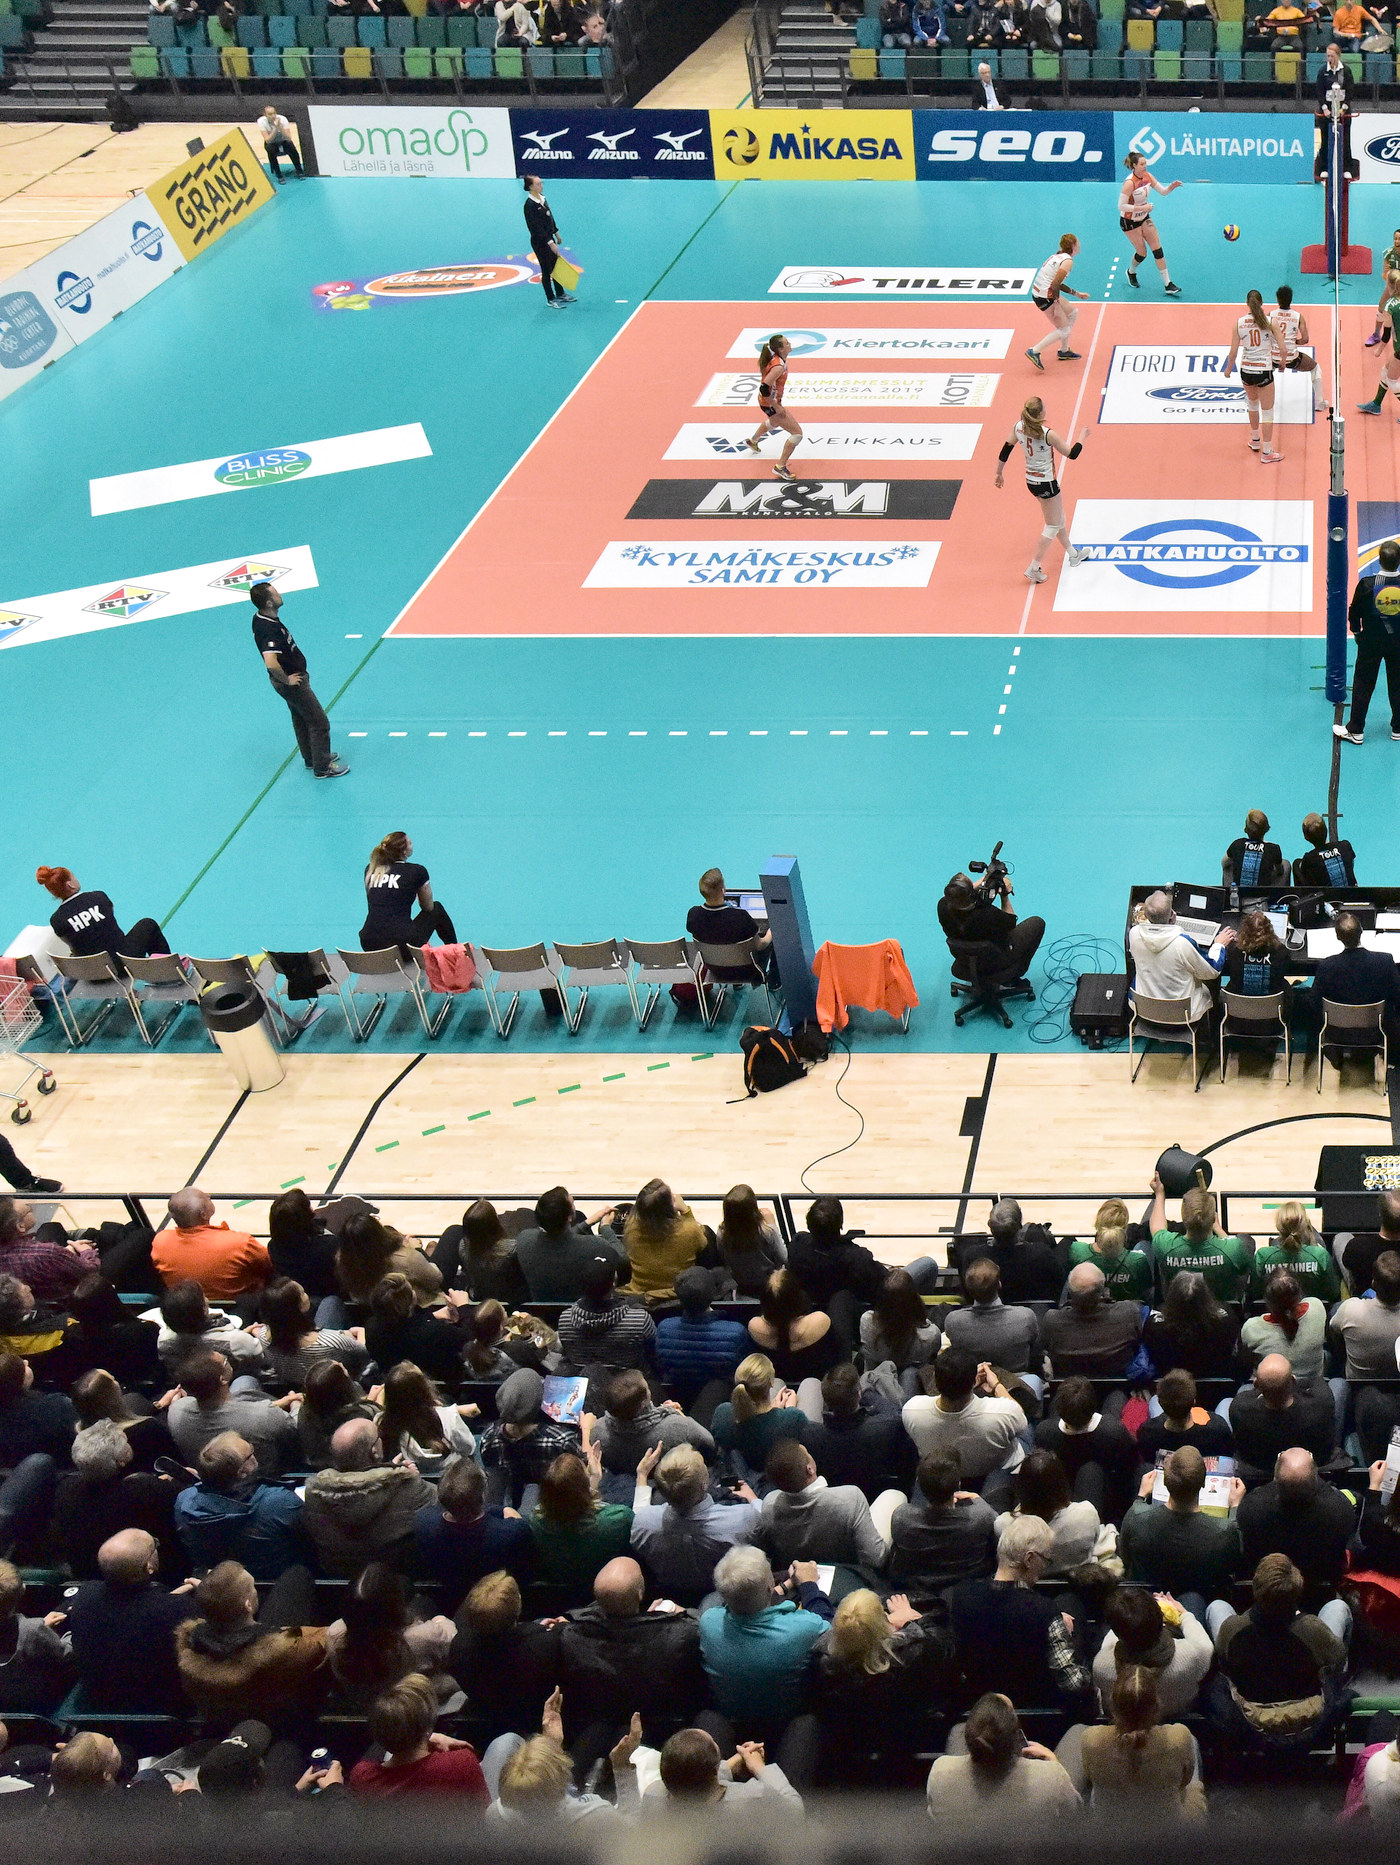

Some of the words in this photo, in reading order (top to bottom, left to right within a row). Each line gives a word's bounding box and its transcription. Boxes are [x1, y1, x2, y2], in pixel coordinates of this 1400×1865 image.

[1170, 134, 1304, 157] LÄHITAPIOLA
[343, 160, 386, 172] Lähellä
[390, 161, 400, 173] ja
[403, 160, 434, 172] läsnä
[175, 159, 248, 229] GRANO
[872, 278, 1023, 289] TIILERI
[833, 338, 990, 350] Kiertokaari
[1249, 329, 1261, 347] 10
[1120, 355, 1175, 373] FORD
[939, 374, 975, 405] KOTI
[807, 437, 943, 446] VEIKKAUS
[1026, 437, 1034, 457] 5
[227, 451, 299, 473] BLISS
[223, 463, 305, 484] CLINIC
[694, 481, 890, 512] M&M
[637, 549, 897, 566] KYLMÄKESKUS
[1081, 546, 1300, 560] MATKAHUOLTO
[687, 568, 780, 584] SAMI
[794, 568, 843, 584] OY
[1245, 842, 1265, 853] TOUR
[1319, 848, 1341, 860] TOUR
[67, 905, 106, 932] HPK
[1166, 1255, 1224, 1268] HAATAINEN
